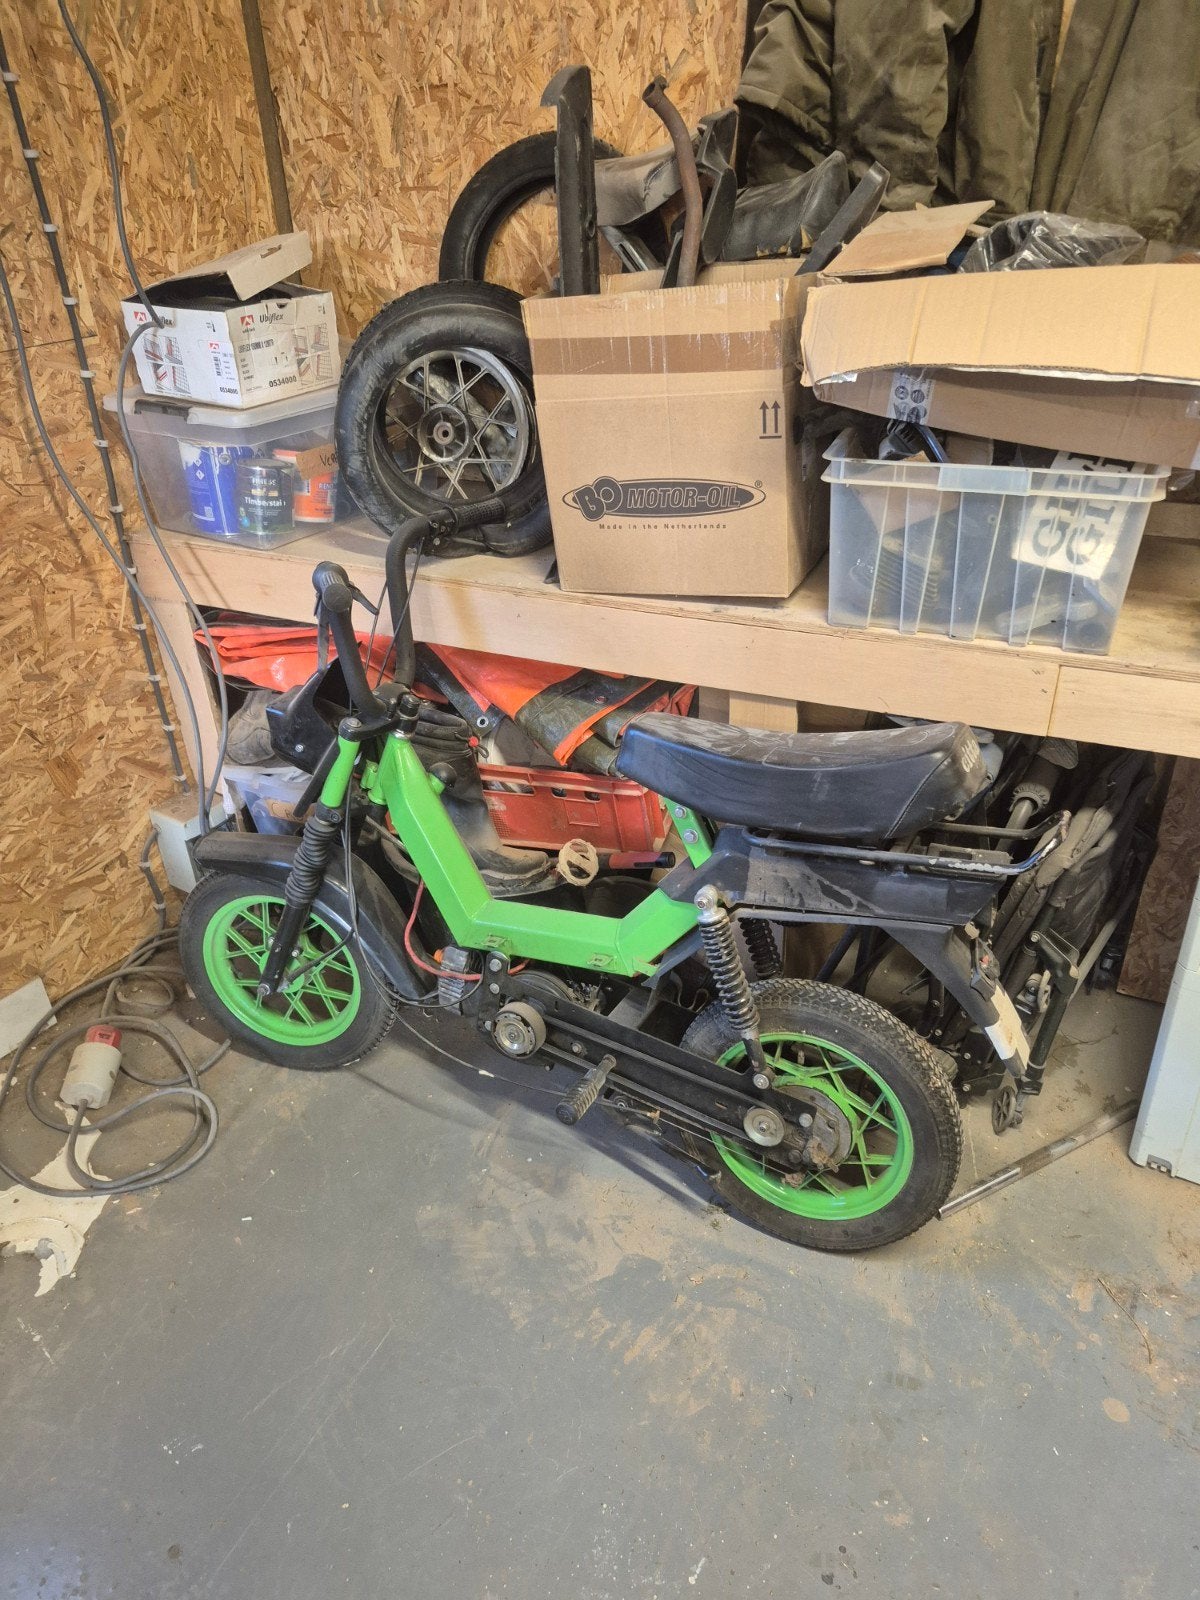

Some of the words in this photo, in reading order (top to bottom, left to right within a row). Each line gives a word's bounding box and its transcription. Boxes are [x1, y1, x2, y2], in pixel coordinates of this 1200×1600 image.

[259, 313, 284, 324] Ubiflex
[268, 375, 297, 388] 0534000
[626, 485, 742, 509] MOTOR-OIL
